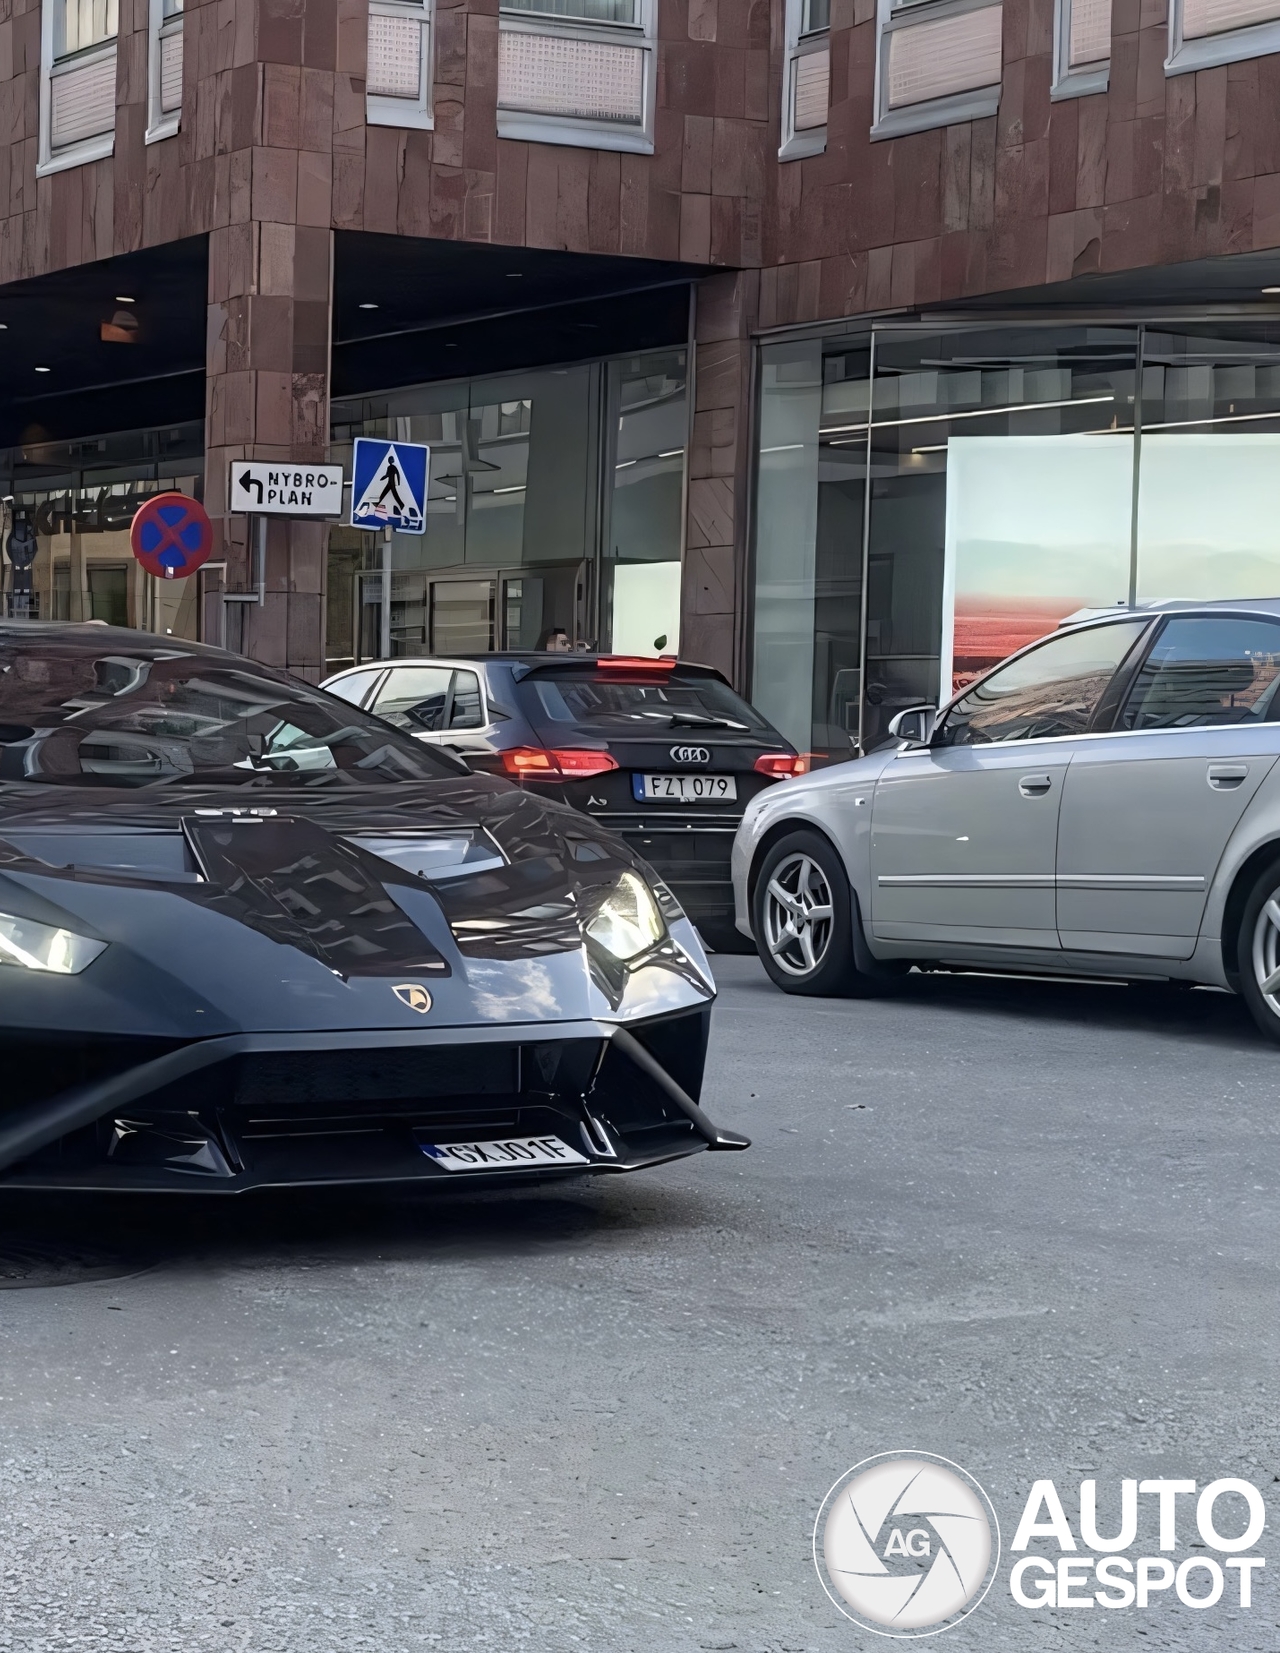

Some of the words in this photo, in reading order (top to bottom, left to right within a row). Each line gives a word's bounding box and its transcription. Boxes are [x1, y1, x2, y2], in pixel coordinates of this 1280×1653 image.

[268, 472, 338, 488] NYBRO-
[268, 489, 312, 506] PLAN
[651, 777, 686, 796] FZT
[693, 778, 728, 797] 079
